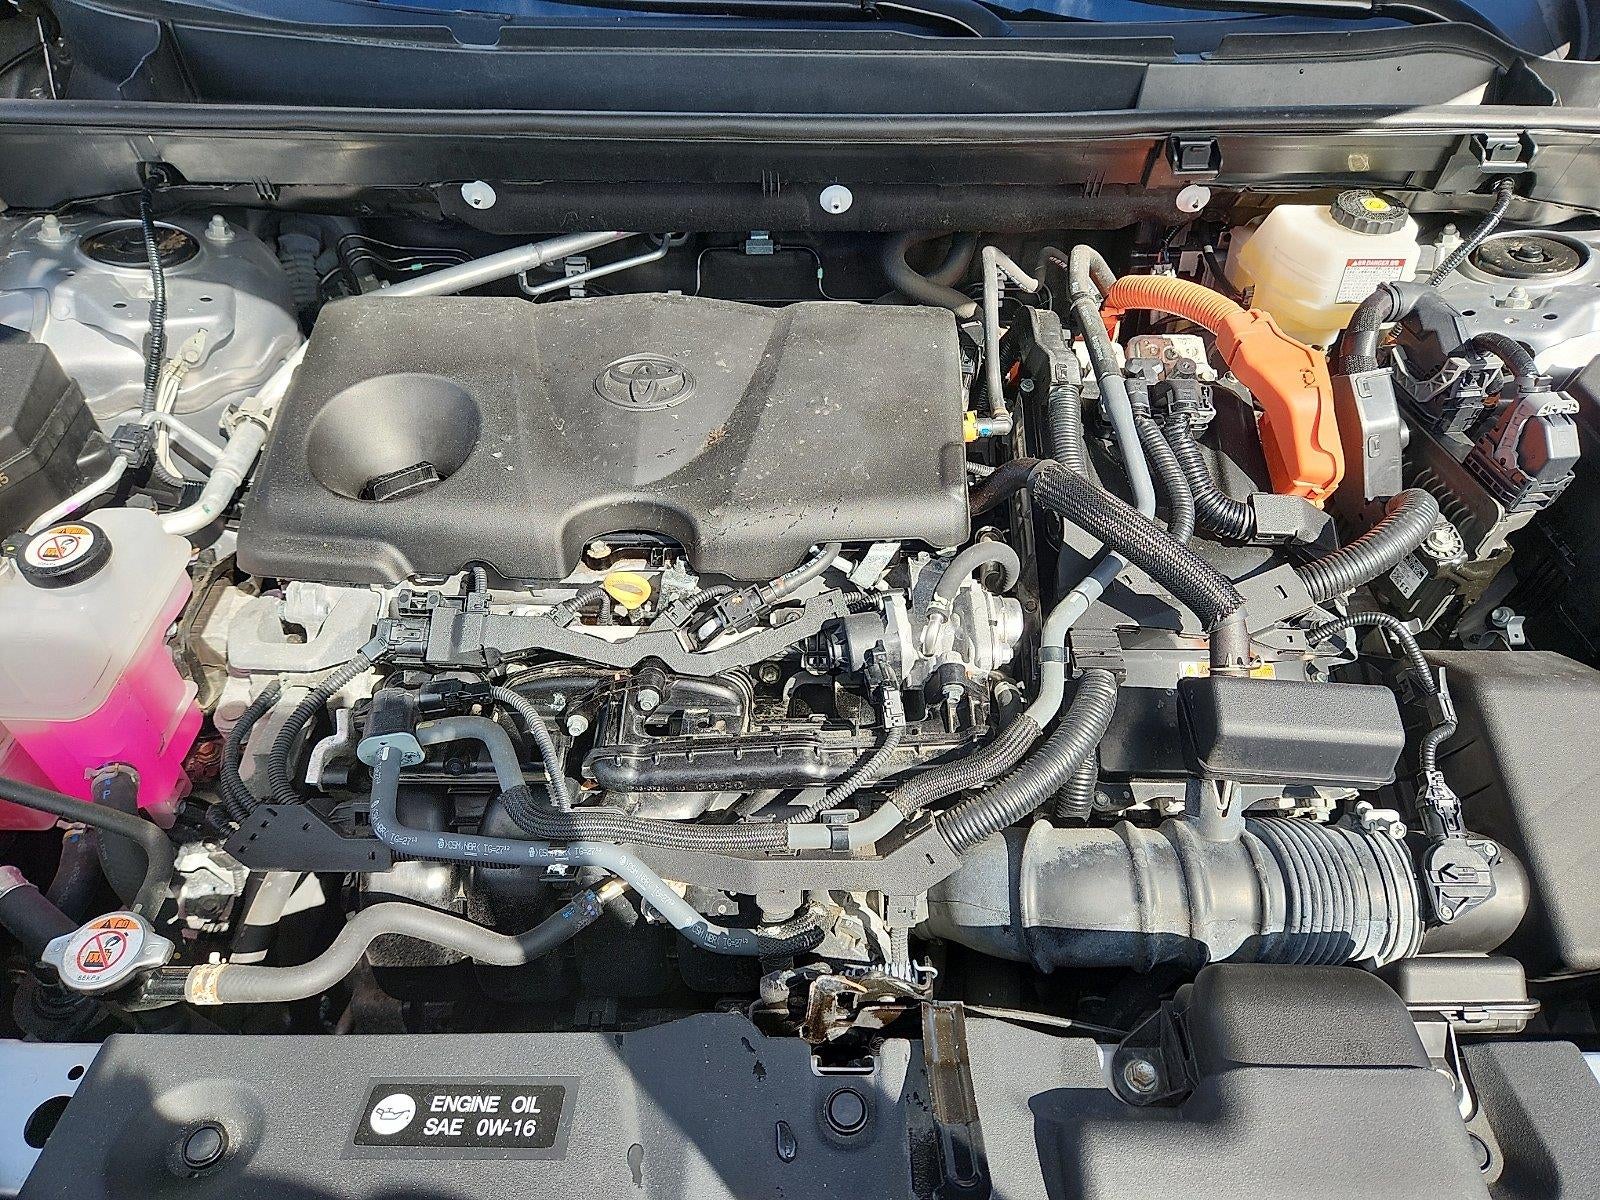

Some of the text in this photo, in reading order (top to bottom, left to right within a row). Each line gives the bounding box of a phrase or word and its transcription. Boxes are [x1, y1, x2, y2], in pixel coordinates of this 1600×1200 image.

[430, 1095, 541, 1114] ENGINE OIL
[423, 1118, 536, 1137] SAE 0W-16
